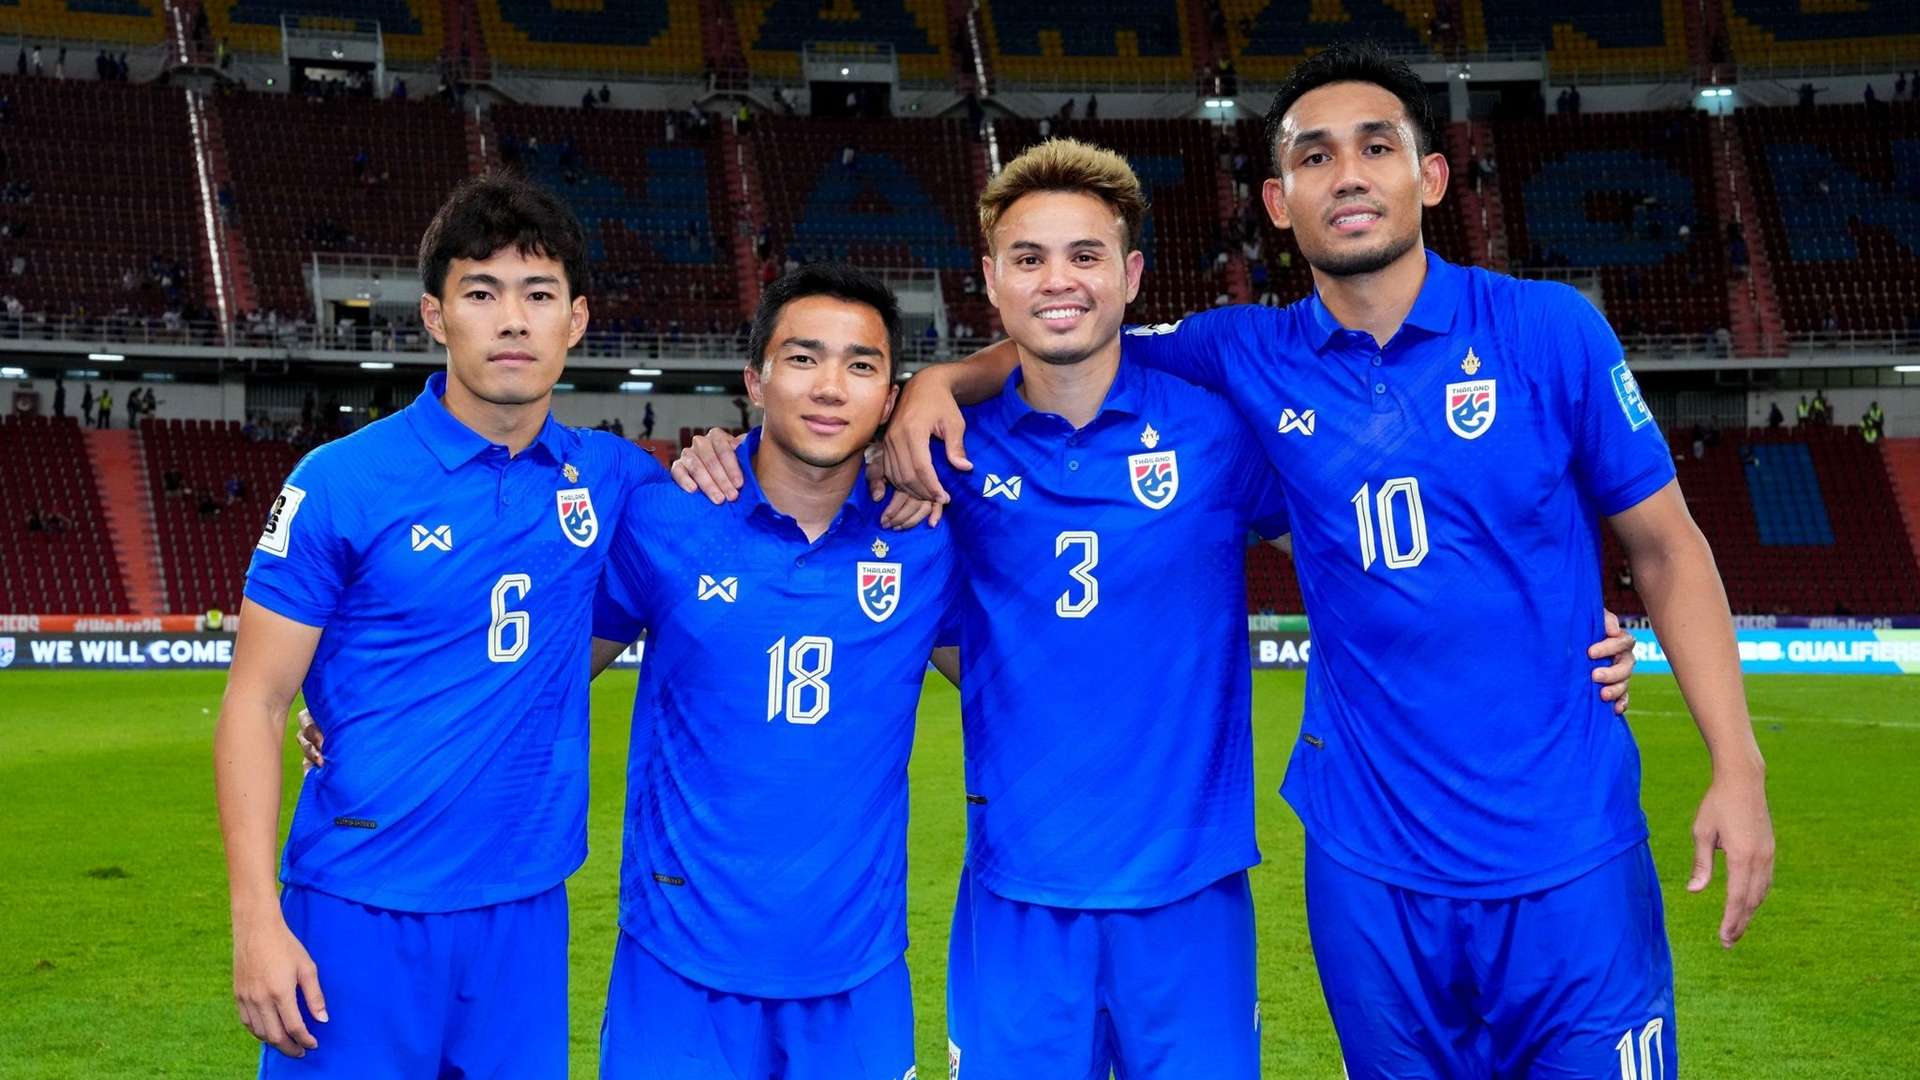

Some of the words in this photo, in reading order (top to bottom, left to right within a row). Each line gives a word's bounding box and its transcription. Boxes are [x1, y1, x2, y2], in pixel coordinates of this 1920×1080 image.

[1452, 385, 1489, 394] THAILAND
[1350, 477, 1429, 572] 10
[1055, 531, 1099, 618] 3
[30, 640, 73, 663] WE
[79, 640, 146, 663] WILL
[150, 640, 232, 663] COME
[488, 573, 531, 663] 6
[1260, 640, 1311, 662] BAC
[766, 635, 833, 724] 18
[1615, 1017, 1664, 1080] 10
